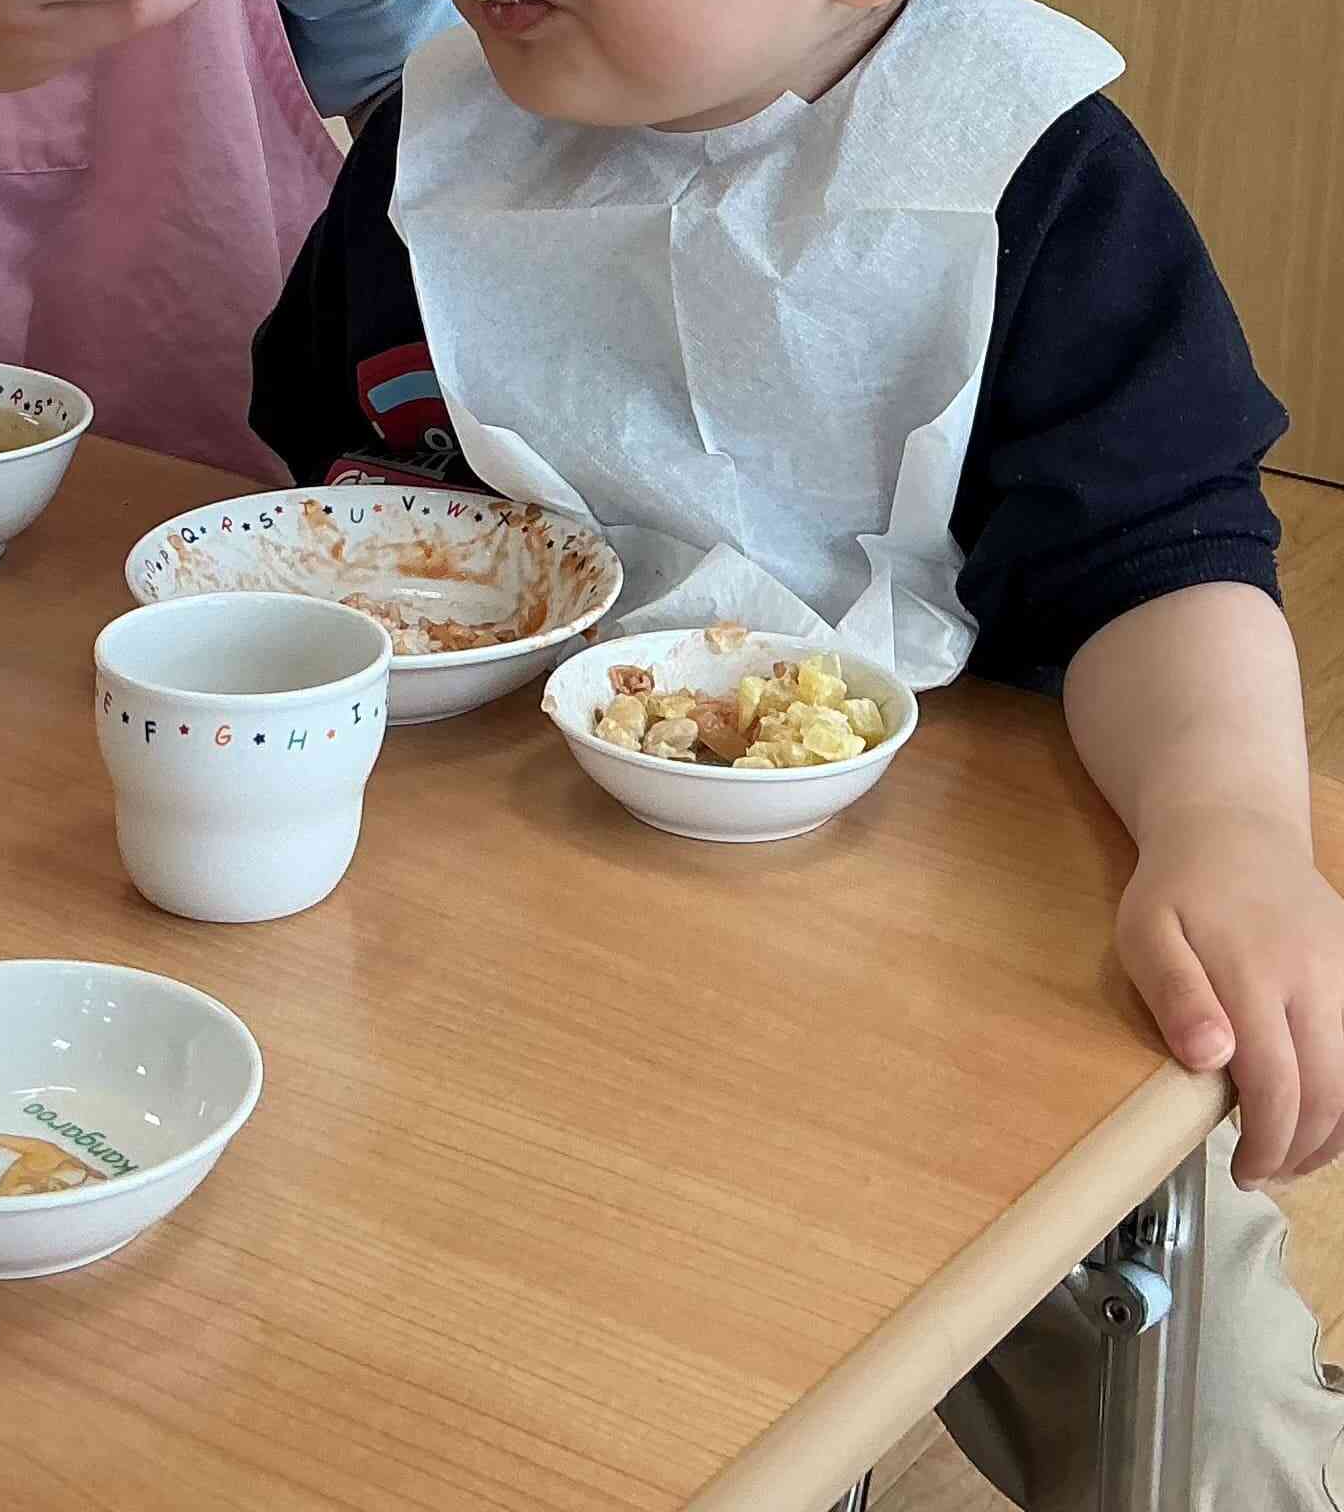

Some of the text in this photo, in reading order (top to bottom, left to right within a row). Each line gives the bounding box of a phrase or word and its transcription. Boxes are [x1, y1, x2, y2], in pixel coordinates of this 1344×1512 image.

[10, 388, 24, 406] R
[34, 399, 44, 416] S
[181, 527, 199, 544] Q
[221, 516, 233, 533] R
[259, 512, 274, 530] S
[350, 507, 364, 524] U
[402, 495, 416, 512] V
[447, 500, 469, 518] W
[497, 511, 513, 527] X
[144, 721, 156, 743] F
[215, 725, 232, 746] G
[287, 730, 307, 750] H
[351, 703, 361, 724] I
